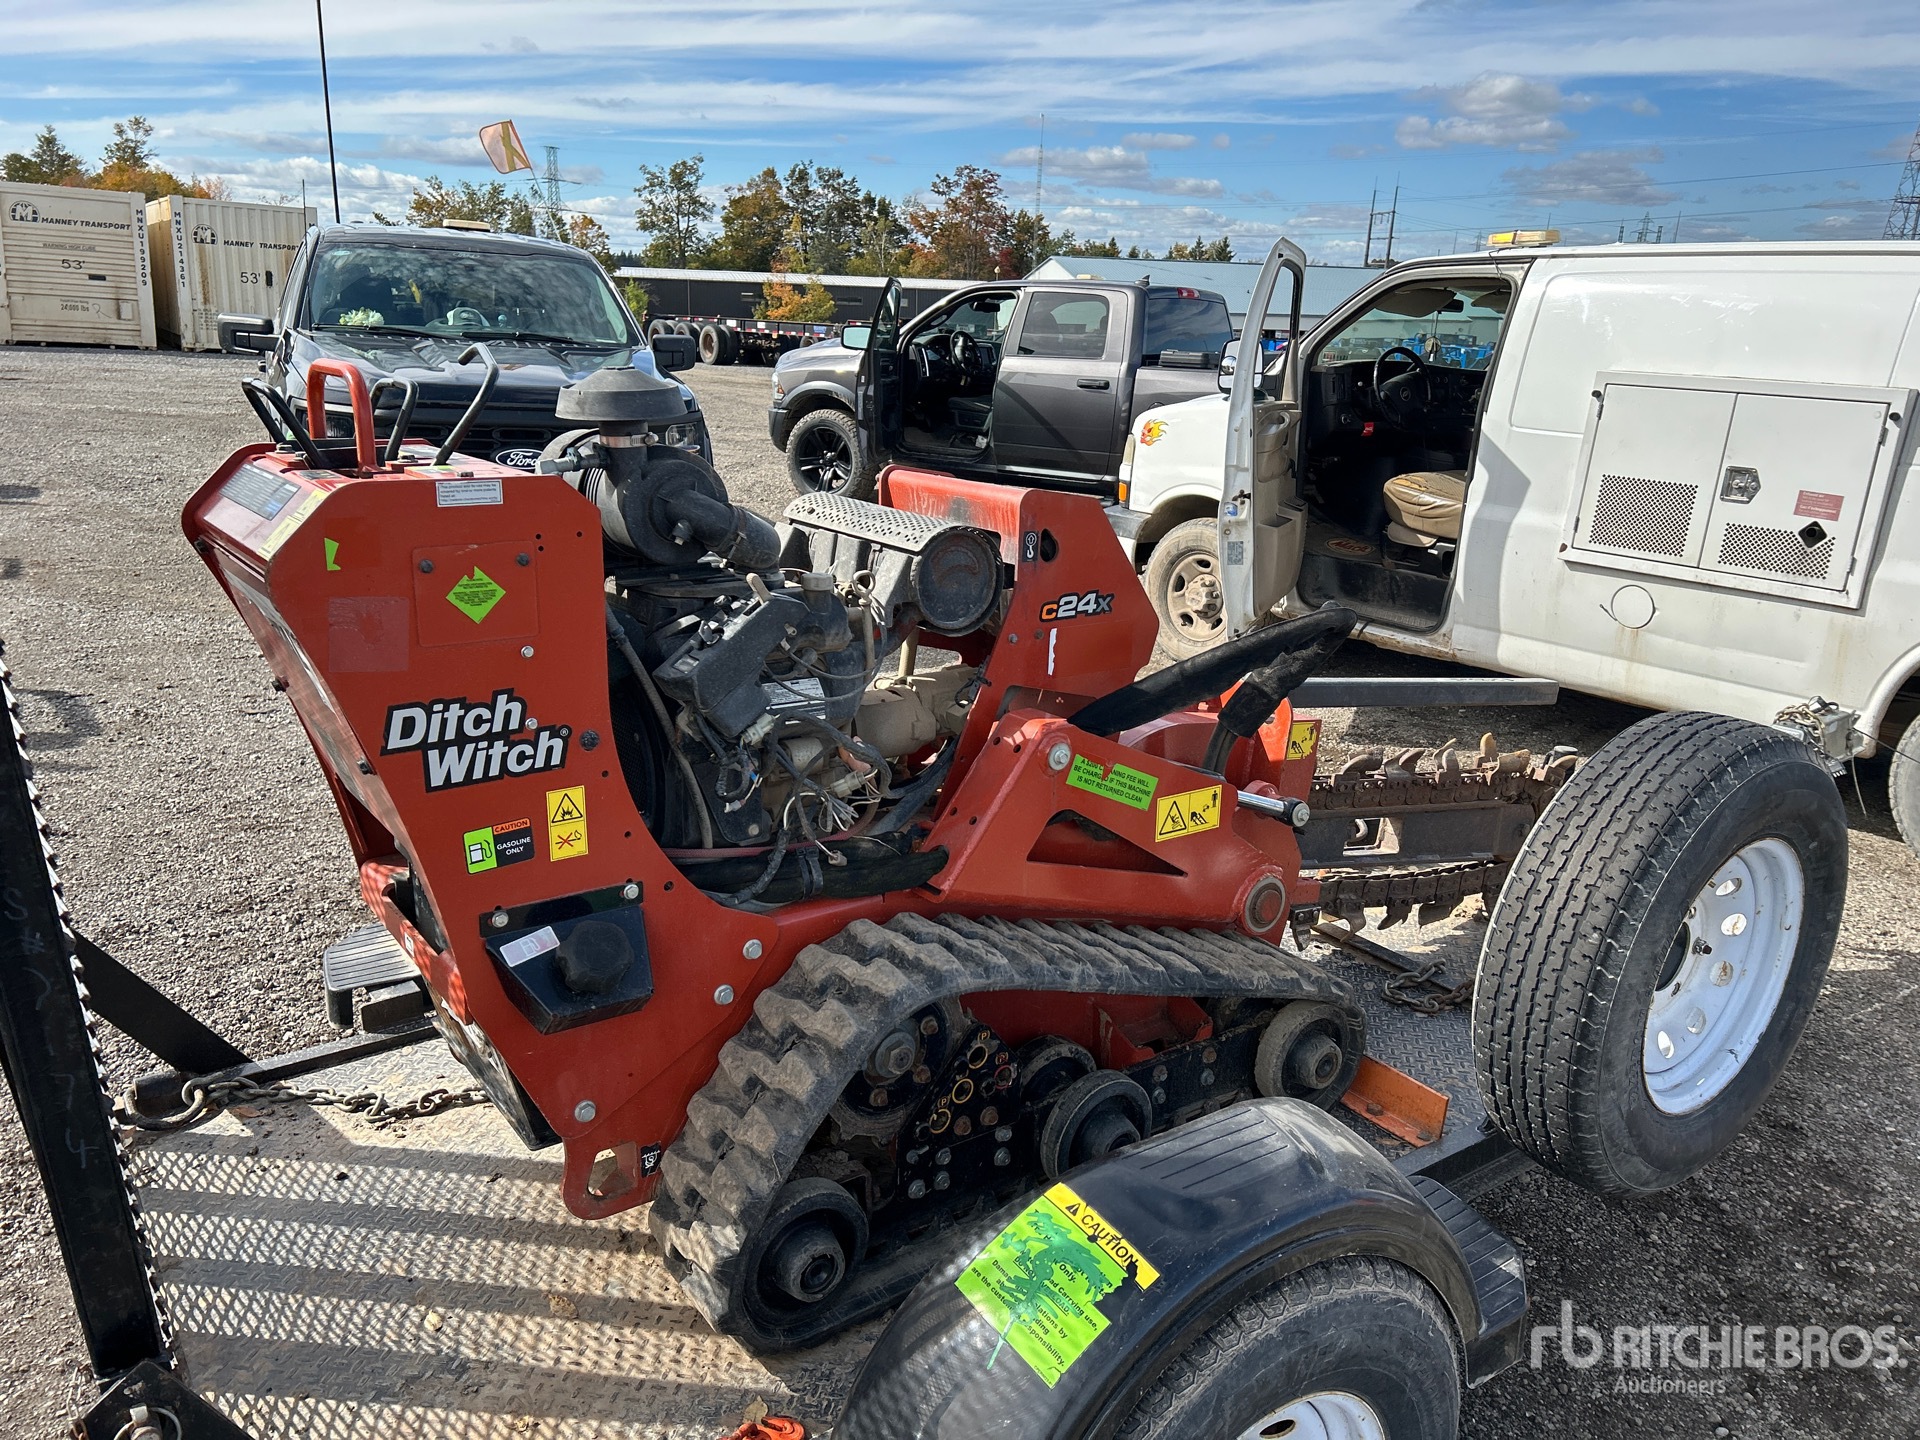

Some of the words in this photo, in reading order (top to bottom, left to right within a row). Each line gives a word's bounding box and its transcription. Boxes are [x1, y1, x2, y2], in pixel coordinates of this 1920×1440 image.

[41, 217, 78, 226] MANNEY
[80, 221, 131, 230] TRANSPORT
[224, 240, 254, 248] MANNEY
[61, 259, 85, 270] 53'
[240, 271, 260, 284] 53'
[386, 694, 522, 750] Ditch
[1127, 774, 1137, 783] FEE
[1137, 778, 1149, 787] WILL
[1084, 778, 1096, 786] NOT
[1096, 781, 1124, 796] RETURNED
[1125, 792, 1142, 802] CLEAN
[1116, 780, 1127, 788] THIS
[1127, 784, 1151, 796] MACHINE
[495, 820, 528, 833] CAUTION
[497, 837, 531, 850] GASOLINE
[506, 846, 524, 855] ONLY
[1081, 1214, 1137, 1266] CAUTION
[970, 1265, 982, 1278] are
[980, 1274, 992, 1288] the
[1056, 1262, 1078, 1284] Only.
[1056, 1285, 1085, 1317] Carrying
[1082, 1313, 1100, 1332] use,
[1056, 1326, 1069, 1340] by
